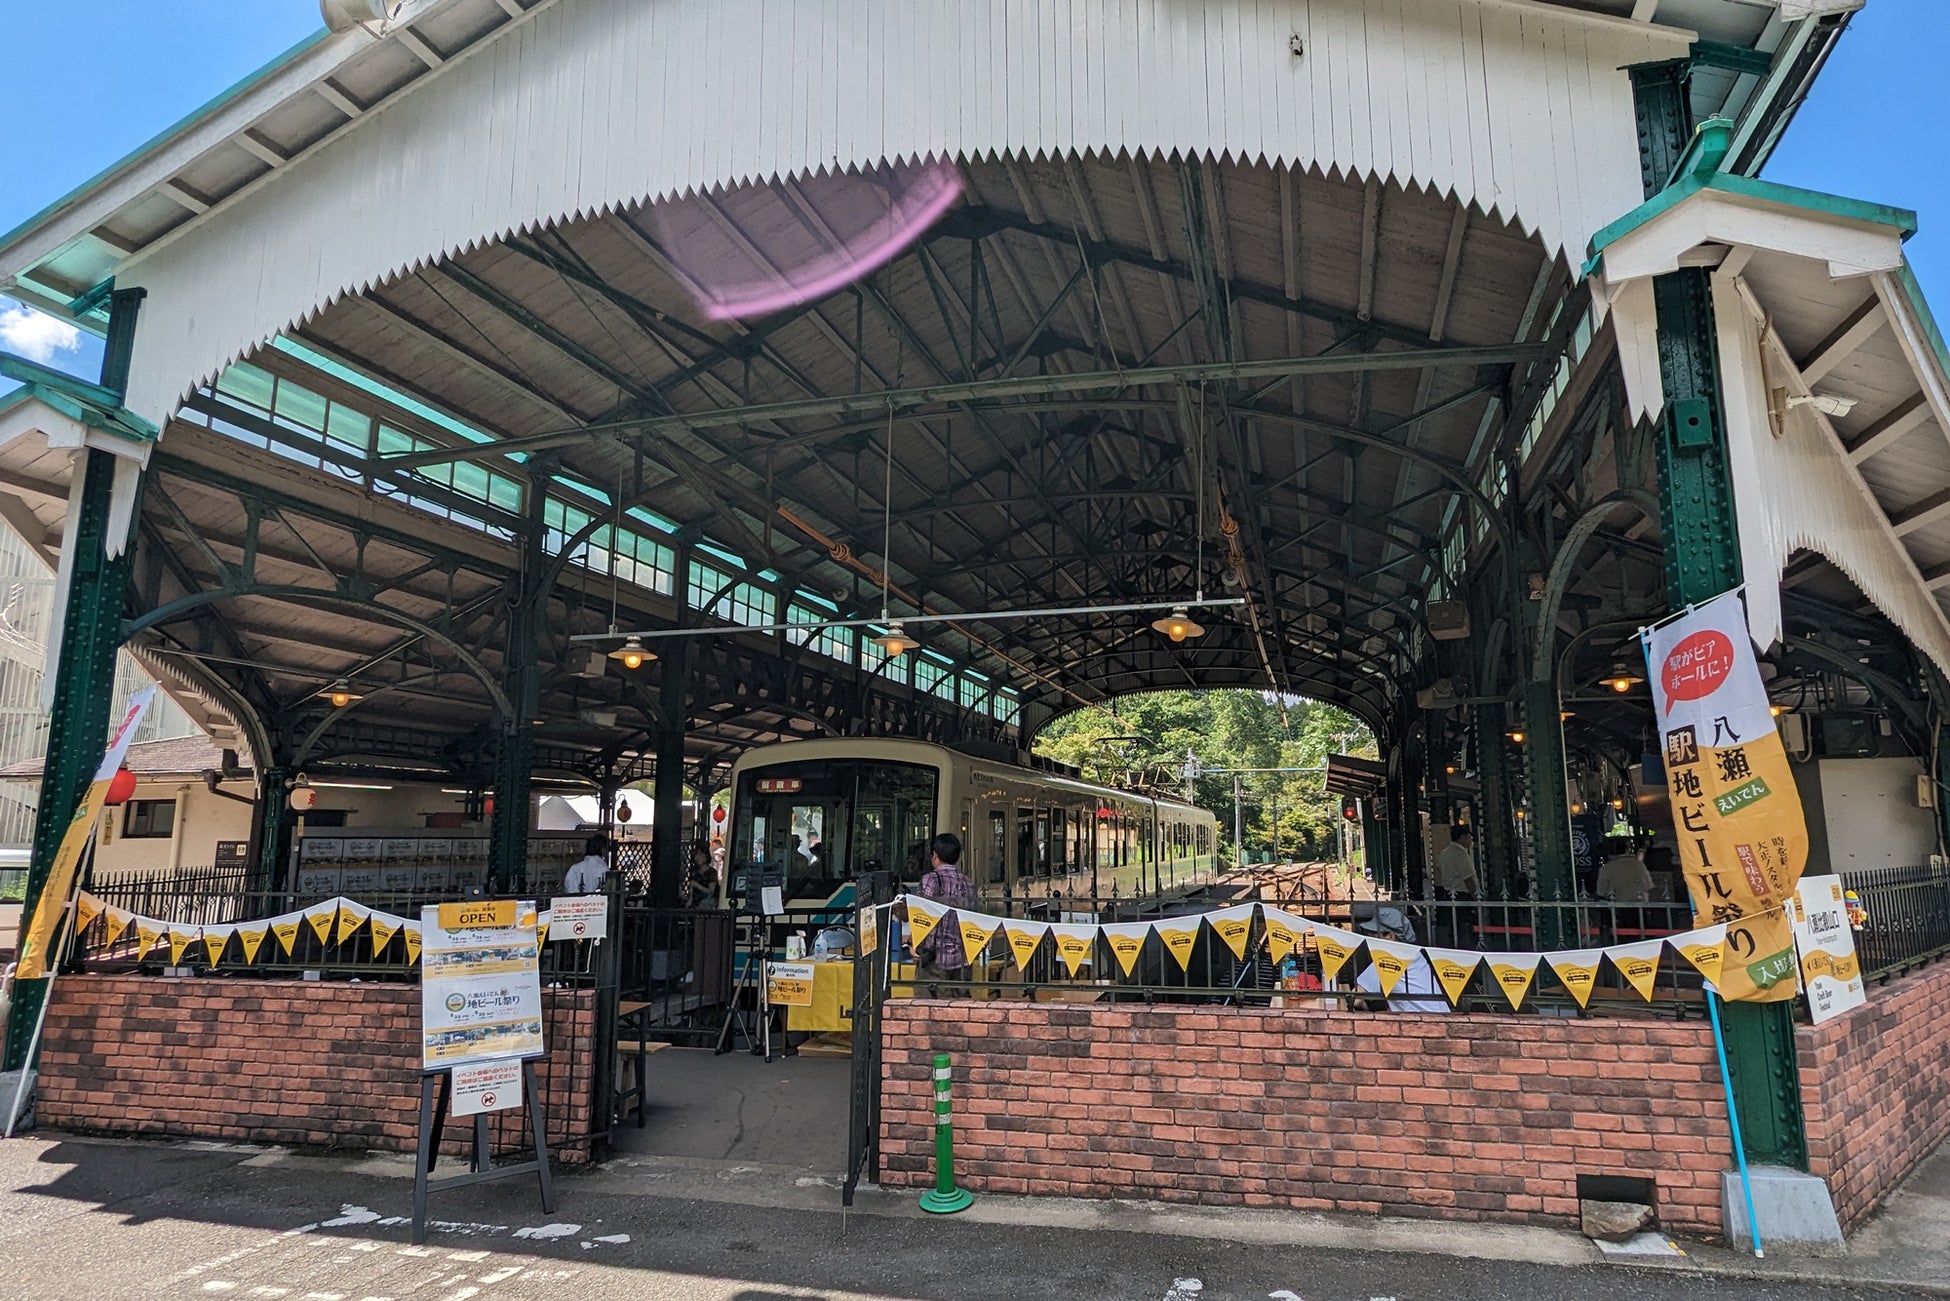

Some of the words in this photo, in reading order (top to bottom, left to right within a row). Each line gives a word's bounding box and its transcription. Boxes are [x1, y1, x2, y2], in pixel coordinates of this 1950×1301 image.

[1669, 640, 1716, 672] 駅がビア
[1713, 716, 1752, 783] 八瀬
[1431, 777, 1441, 792] 1
[1718, 783, 1765, 812] えいでん
[460, 912, 496, 924] OPEN
[777, 965, 809, 975] Information
[467, 995, 520, 1009] 地ビール祭り
